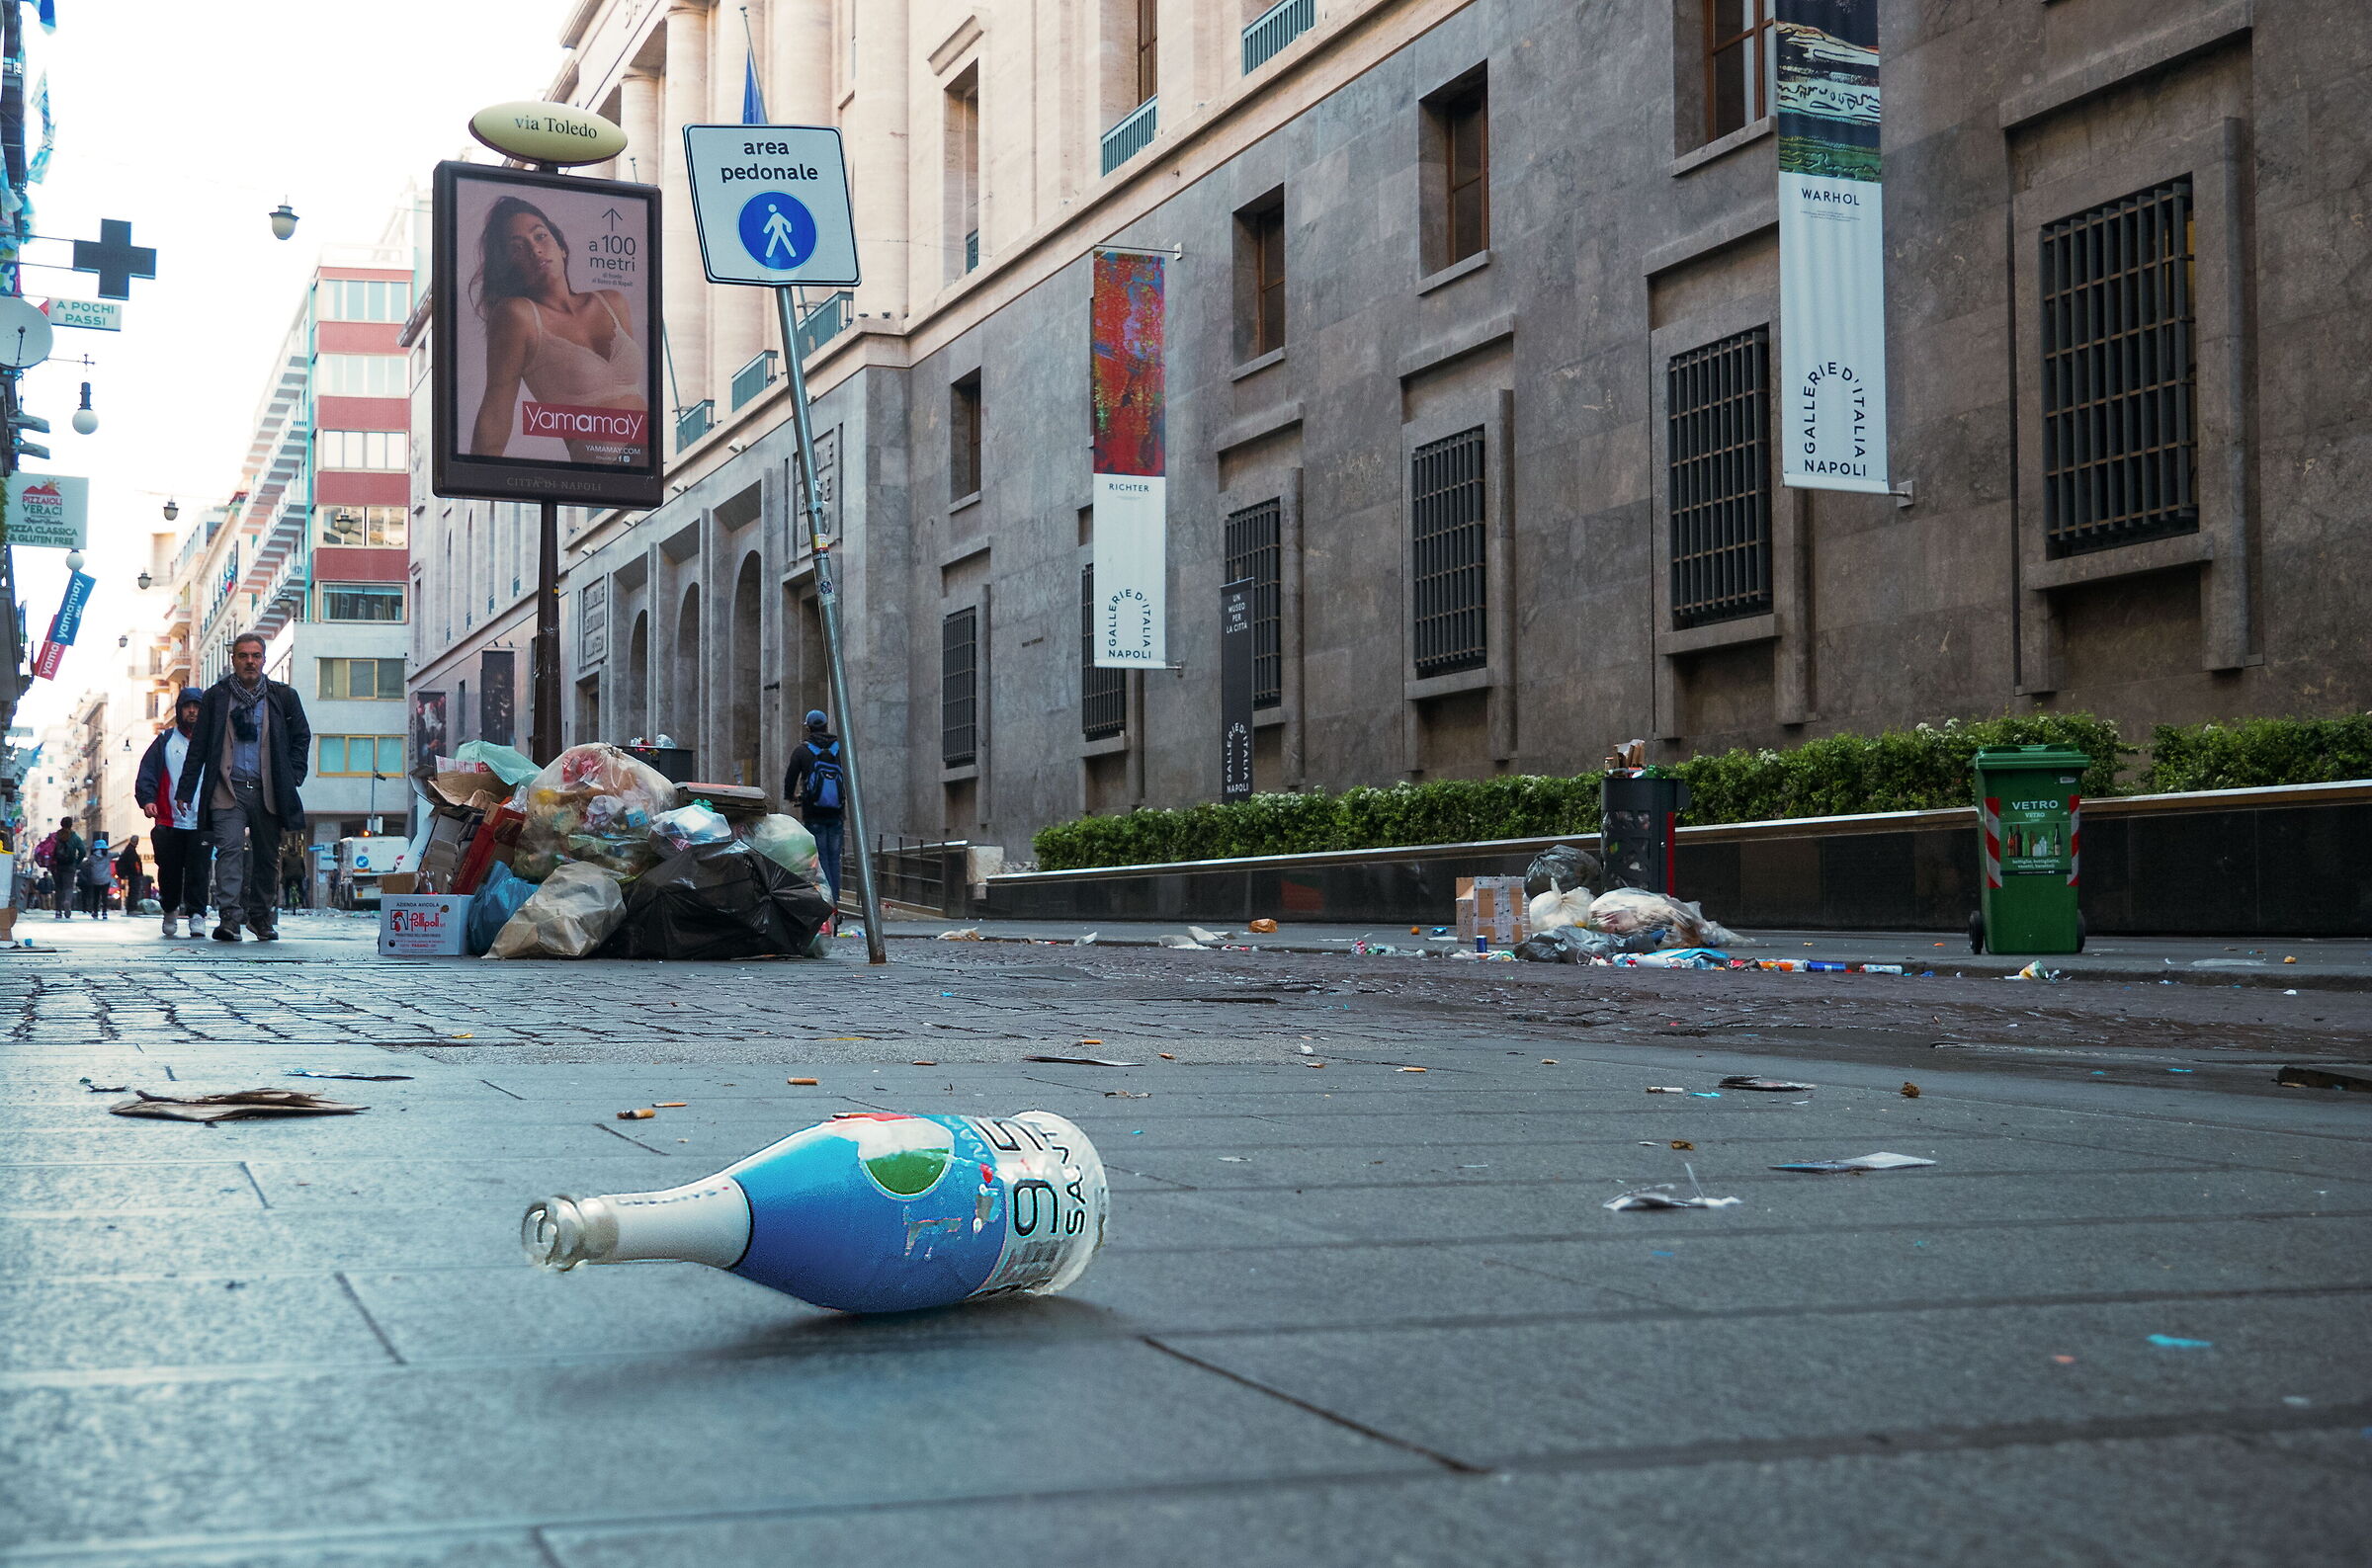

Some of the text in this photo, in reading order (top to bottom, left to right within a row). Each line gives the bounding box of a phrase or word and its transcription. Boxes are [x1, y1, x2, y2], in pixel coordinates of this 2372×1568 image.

[515, 115, 598, 139] via Toledo
[743, 141, 790, 155] area
[720, 163, 818, 183] pedonale
[1801, 188, 1860, 206] WARHOL
[589, 234, 636, 256] a 100
[589, 256, 635, 272] metri
[56, 300, 115, 314] A POCHI
[65, 313, 106, 326] PASSI
[1804, 362, 1866, 457] GALLERIE D'ITALIA
[585, 445, 641, 455] YAMAMAY.COM
[1804, 459, 1866, 476] NAPOLI
[560, 481, 602, 491] NAPOLI
[1109, 483, 1149, 492] RICHTER
[22, 495, 63, 506] PIZZAIOLI
[23, 504, 62, 516] VERACI
[7, 524, 78, 536] PIZZA CLASSICA
[18, 535, 52, 544] GLUTEN
[53, 536, 74, 545] FREE
[56, 578, 84, 638] yamamay
[1228, 602, 1245, 613] MUSEO
[1108, 589, 1151, 648] GALLERIE D'ITALIA
[1231, 613, 1241, 622] PER
[42, 641, 61, 675] yama
[1108, 649, 1151, 659] NAPOLI
[1227, 722, 1238, 783] GALLERIE
[1227, 783, 1249, 793] NAPOLI
[2011, 799, 2059, 810] VETRO
